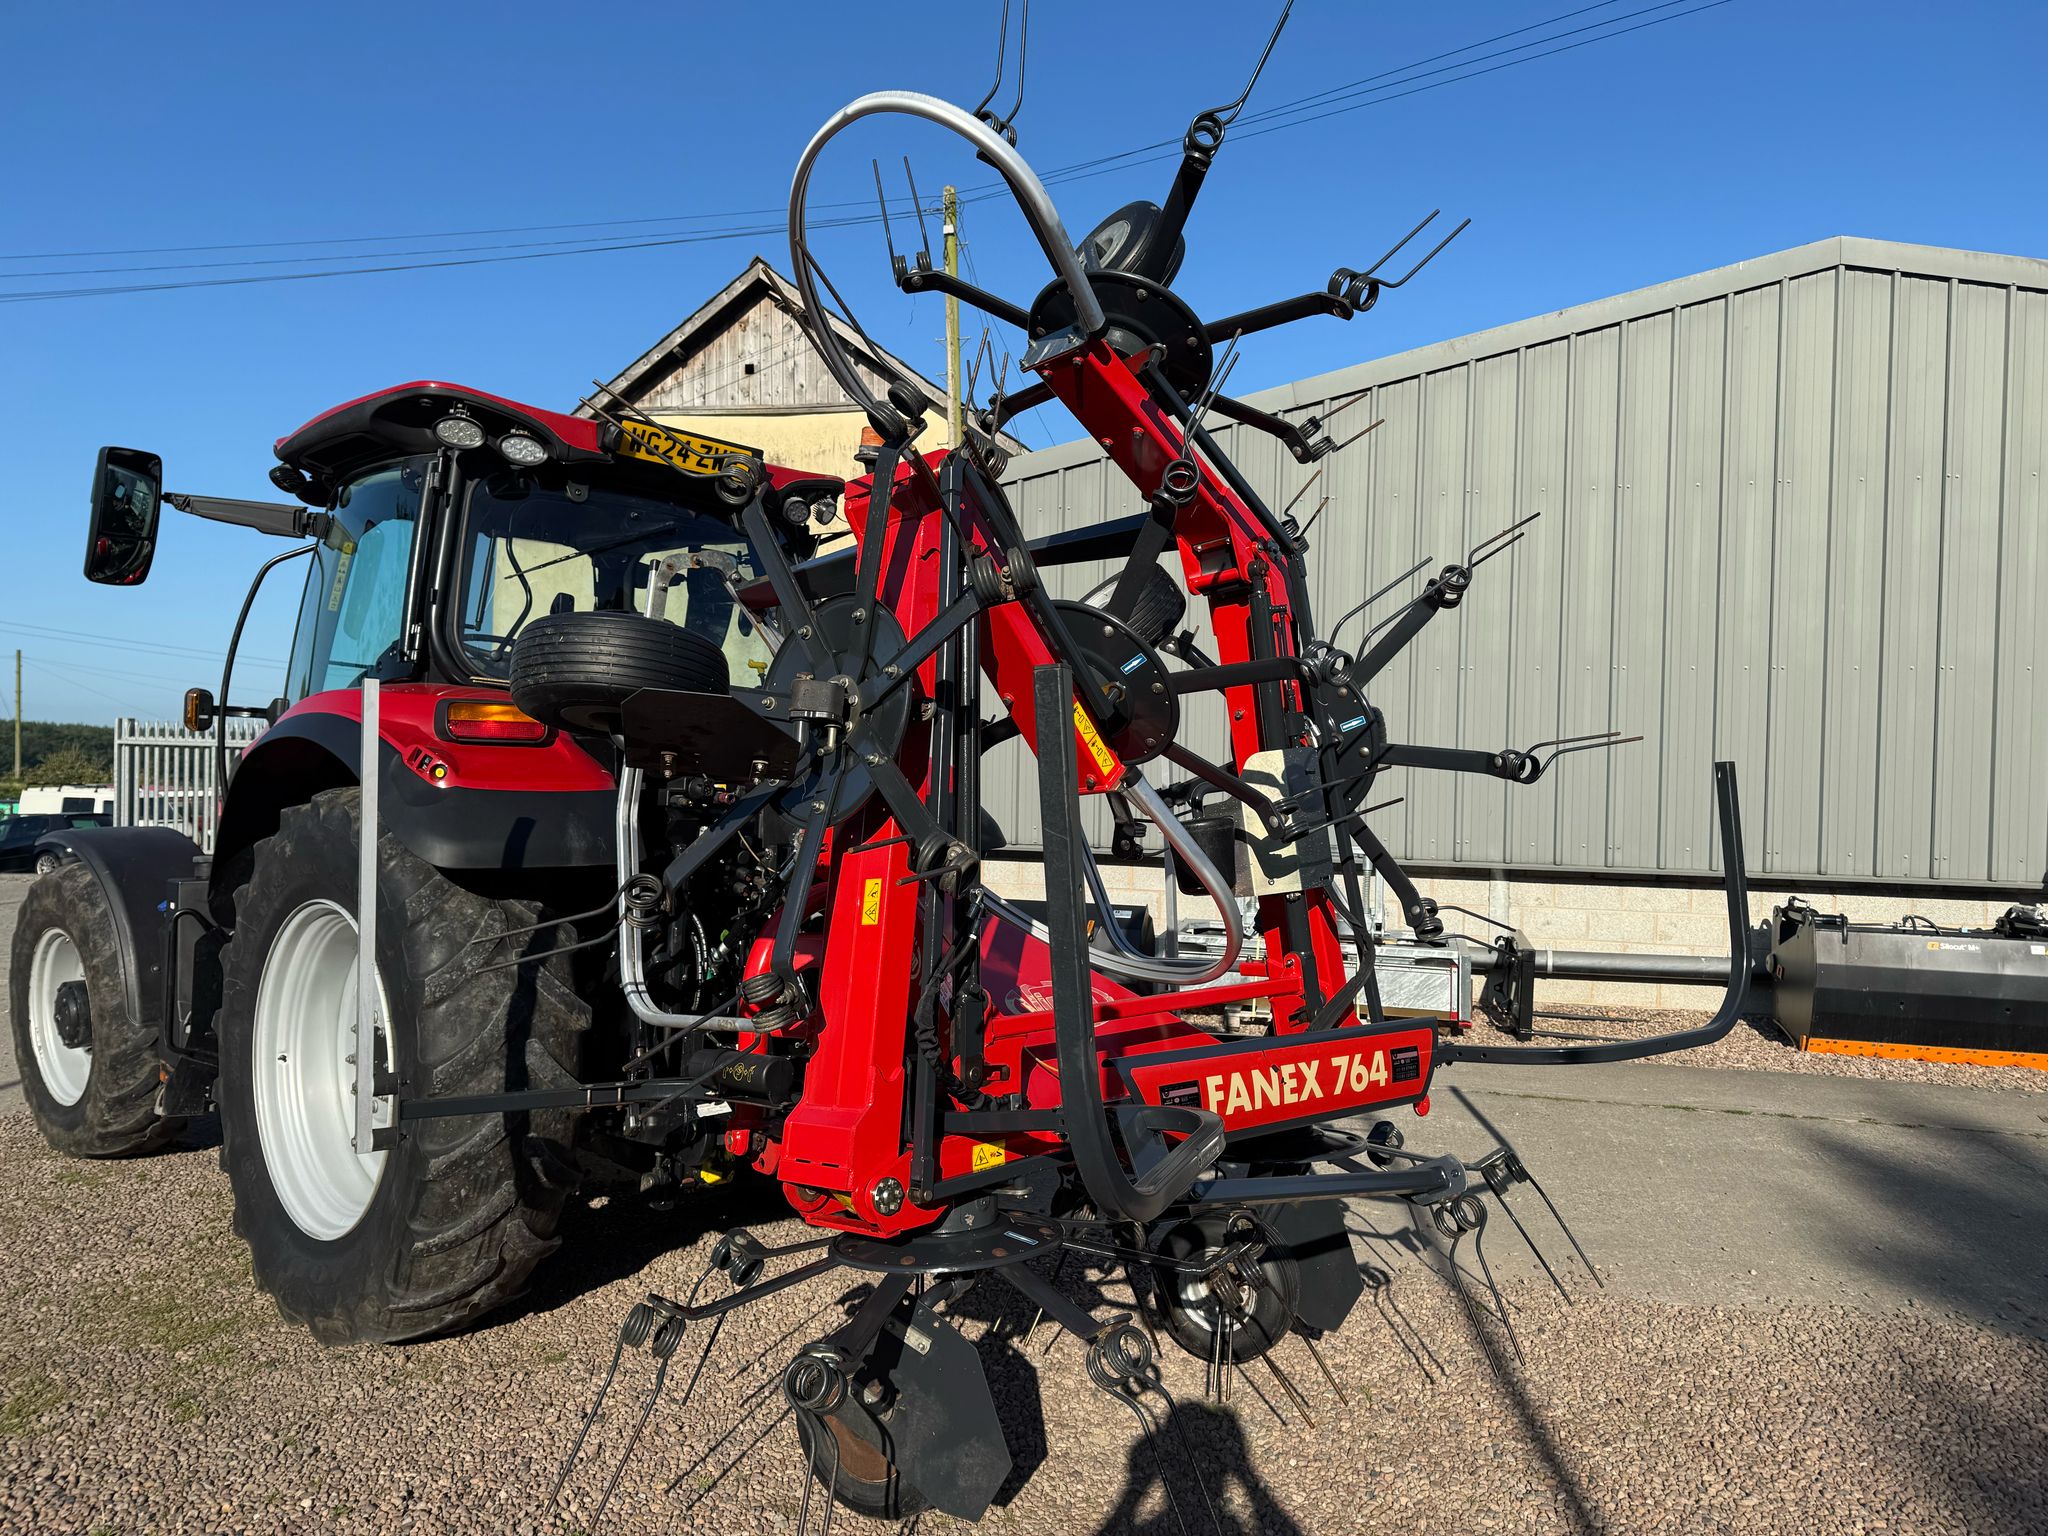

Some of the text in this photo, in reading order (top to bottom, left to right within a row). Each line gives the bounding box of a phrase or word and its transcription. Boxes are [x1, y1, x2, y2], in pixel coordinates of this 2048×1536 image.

[629, 427, 739, 471] WG24 ZW
[1206, 1060, 1324, 1116] FANEX
[1331, 1050, 1388, 1095] 764
